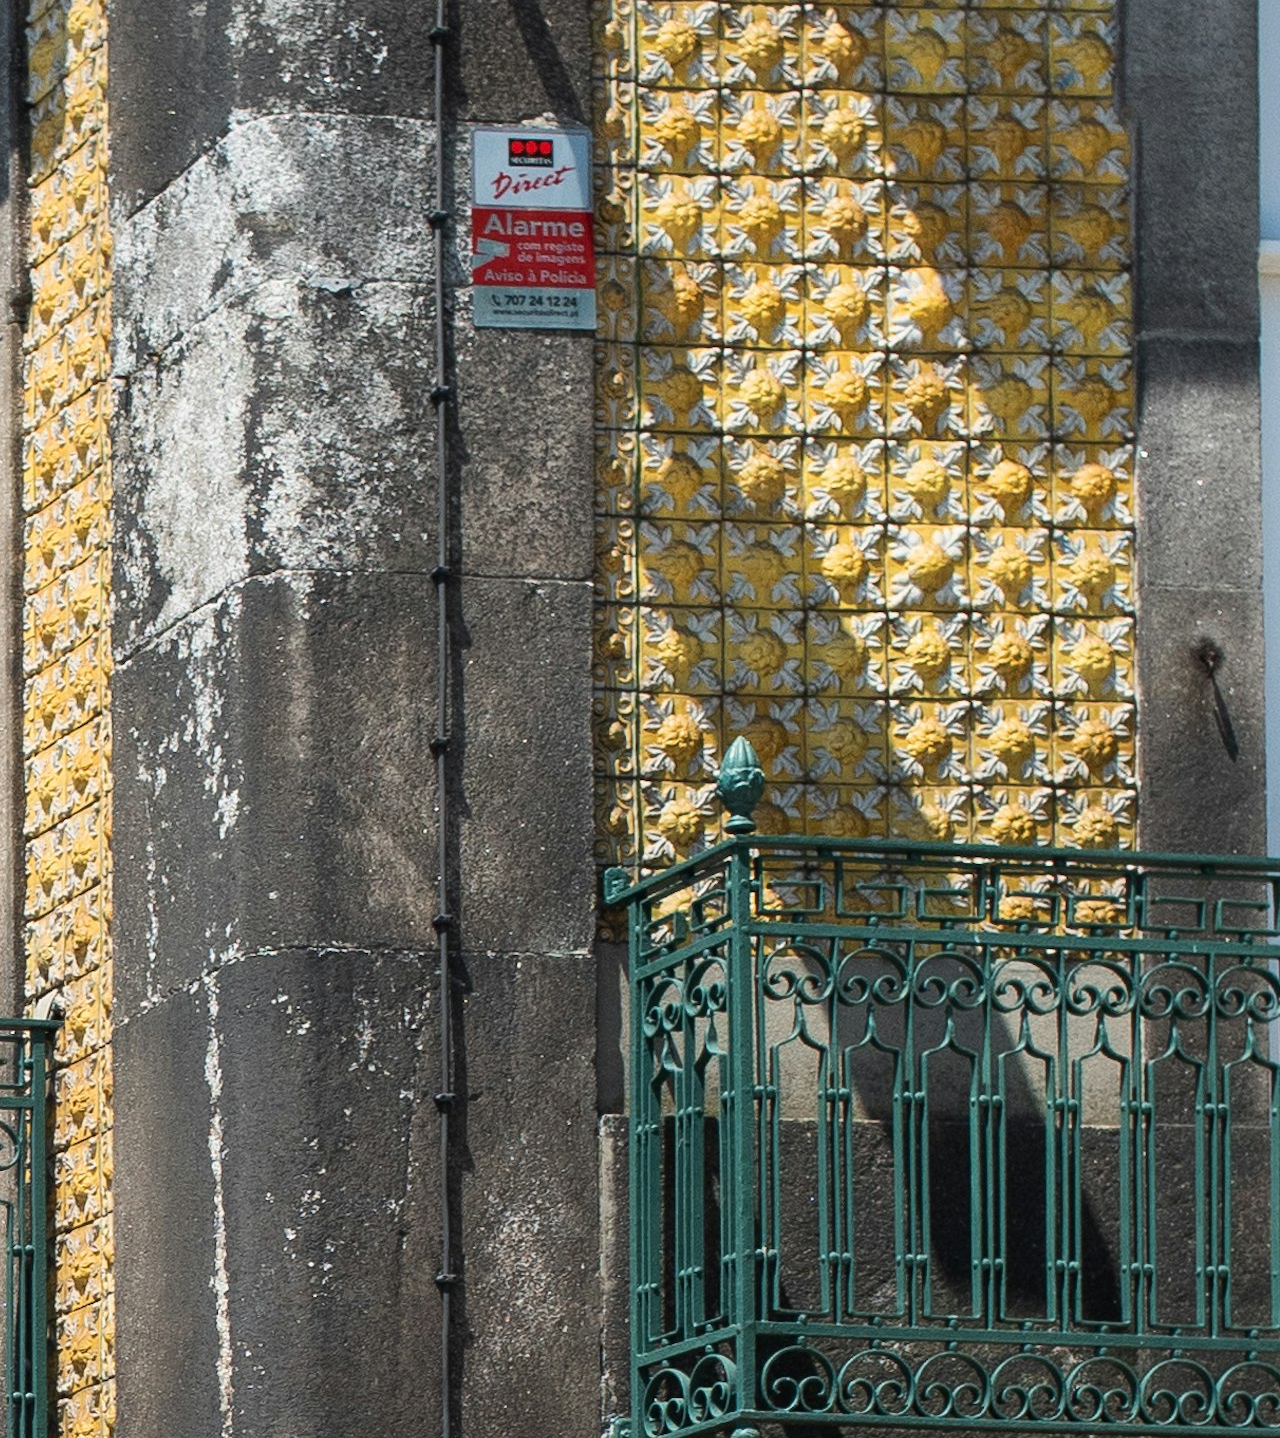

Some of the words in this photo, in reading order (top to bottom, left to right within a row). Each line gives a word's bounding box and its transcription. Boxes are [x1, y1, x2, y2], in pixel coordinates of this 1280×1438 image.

[491, 166, 577, 200] Direct
[484, 212, 586, 238] Alarme
[517, 242, 541, 251] com
[544, 242, 585, 254] registo
[517, 253, 534, 263] de
[536, 252, 586, 267] imagens
[484, 268, 524, 282] Aviso
[504, 294, 526, 306] 707
[529, 295, 544, 306] 24
[546, 296, 561, 307] 12
[562, 296, 578, 308] 24
